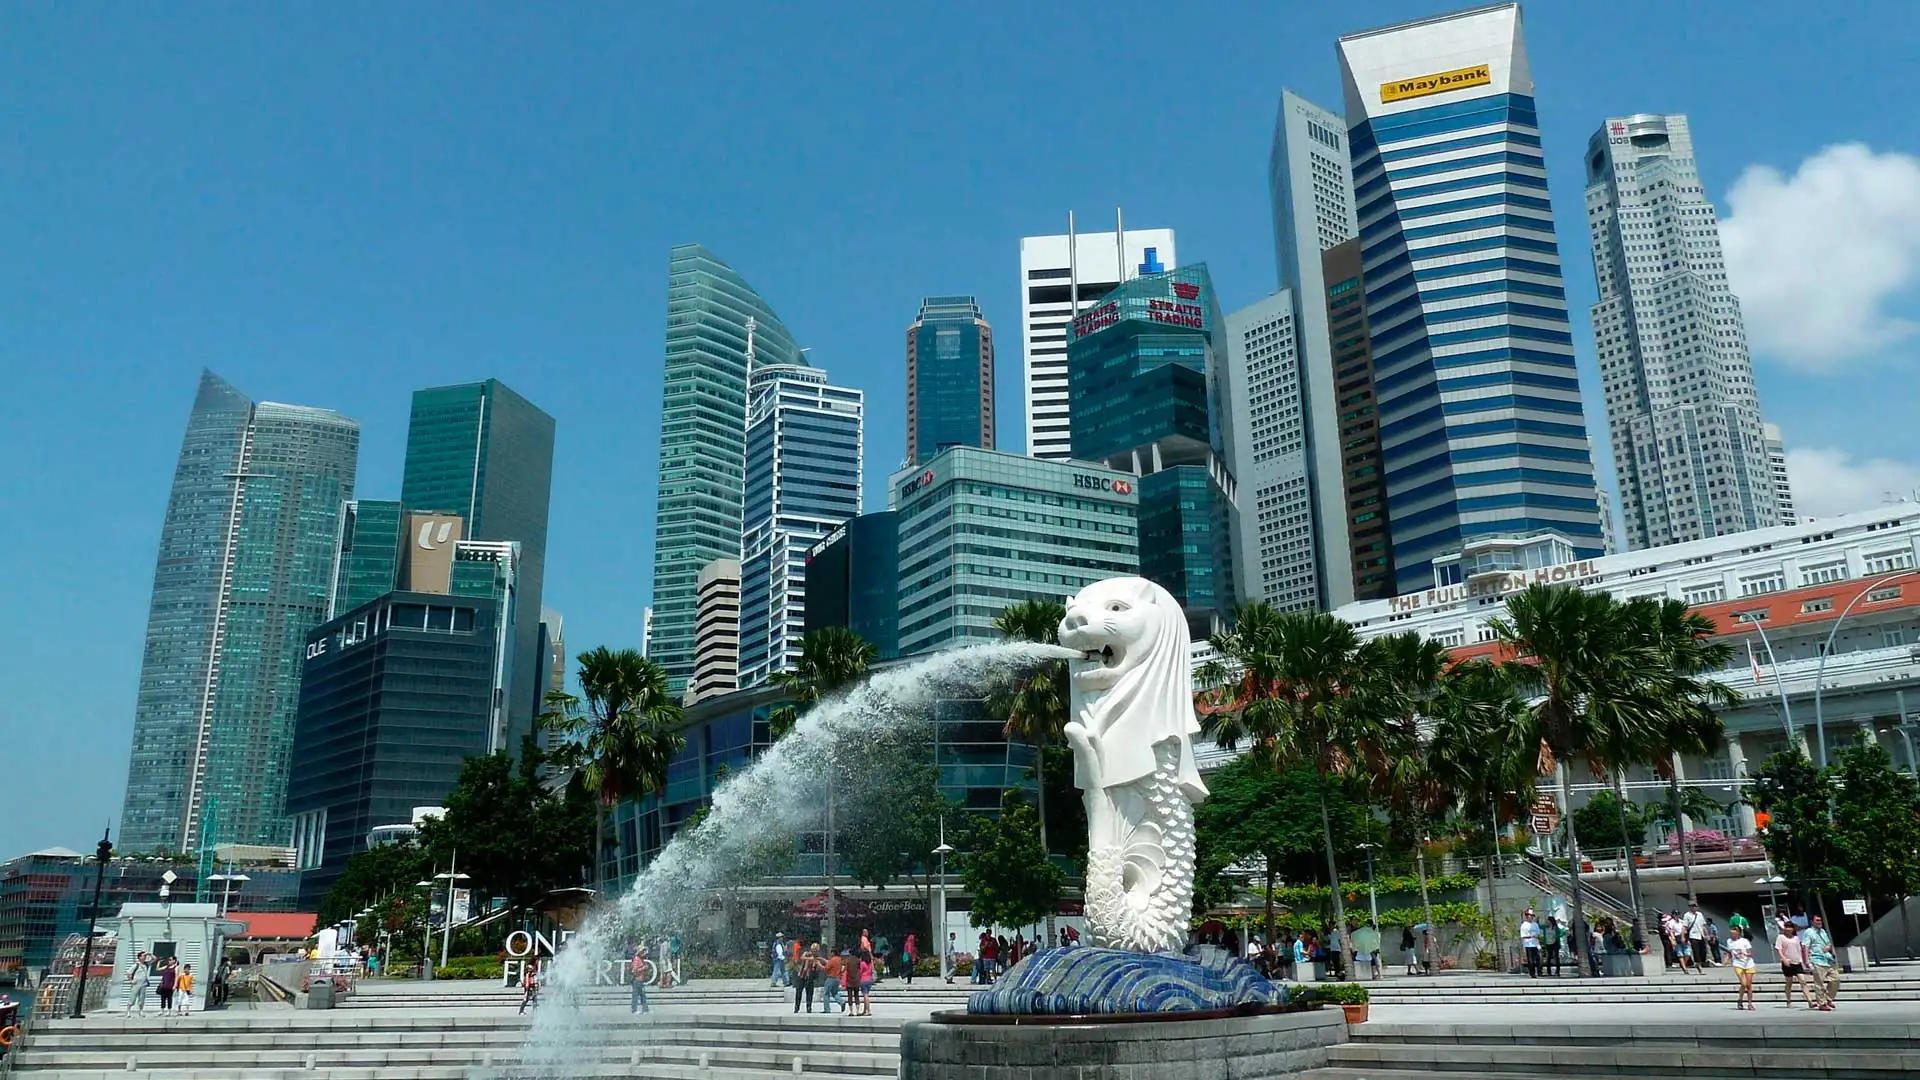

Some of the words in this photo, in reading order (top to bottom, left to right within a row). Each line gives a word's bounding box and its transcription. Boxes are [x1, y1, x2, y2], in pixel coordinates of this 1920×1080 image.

[1399, 70, 1487, 92] Maybank
[1610, 137, 1630, 145] UOB
[1074, 301, 1118, 327] STRAITS
[1147, 310, 1203, 328] TRADING
[1149, 300, 1202, 317] STRAITS
[1074, 312, 1120, 337] TRADING
[902, 476, 922, 499] HSBC
[1073, 473, 1111, 492] HSBC
[1389, 595, 1421, 613] THE
[1427, 573, 1527, 605] FULLERTON
[1535, 560, 1599, 583] HOTEL
[307, 637, 328, 660] OUE
